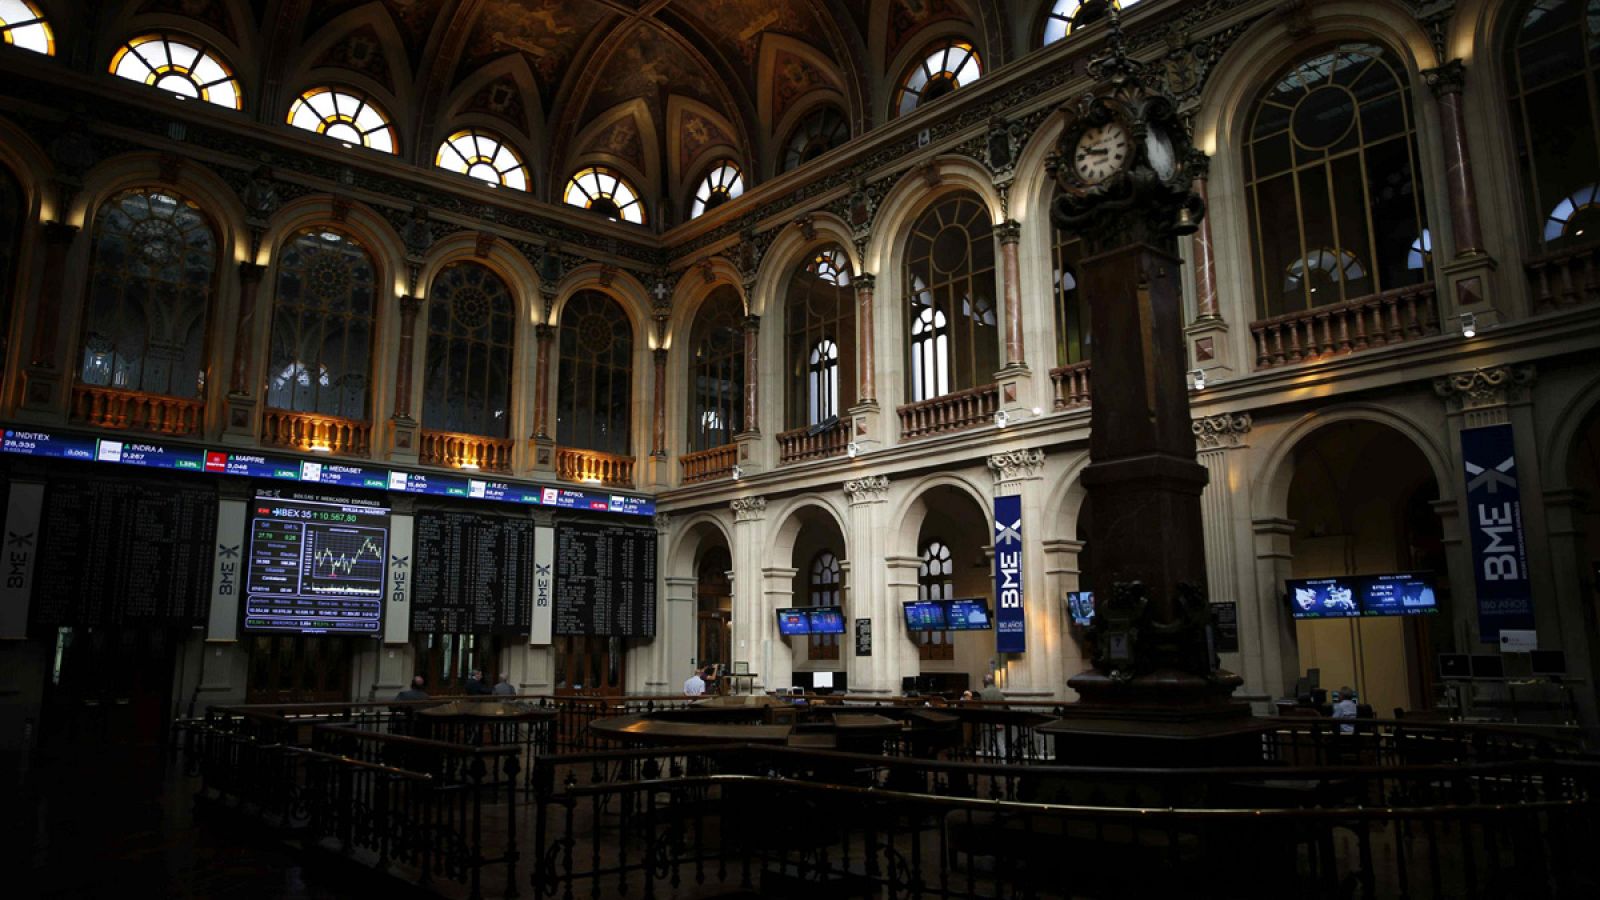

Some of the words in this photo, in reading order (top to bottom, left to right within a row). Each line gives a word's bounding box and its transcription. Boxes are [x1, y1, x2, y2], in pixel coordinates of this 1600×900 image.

[15, 431, 50, 441] INDITEX
[131, 443, 157, 453] INDRA
[235, 455, 265, 465] MAPFRE
[329, 465, 362, 475] MEDIASET
[301, 510, 313, 519] 35
[1478, 501, 1517, 581] BME
[7, 552, 27, 588] BME
[219, 562, 234, 595] BME
[1000, 551, 1020, 609] BME
[392, 571, 405, 602] BME
[537, 578, 548, 608] BME
